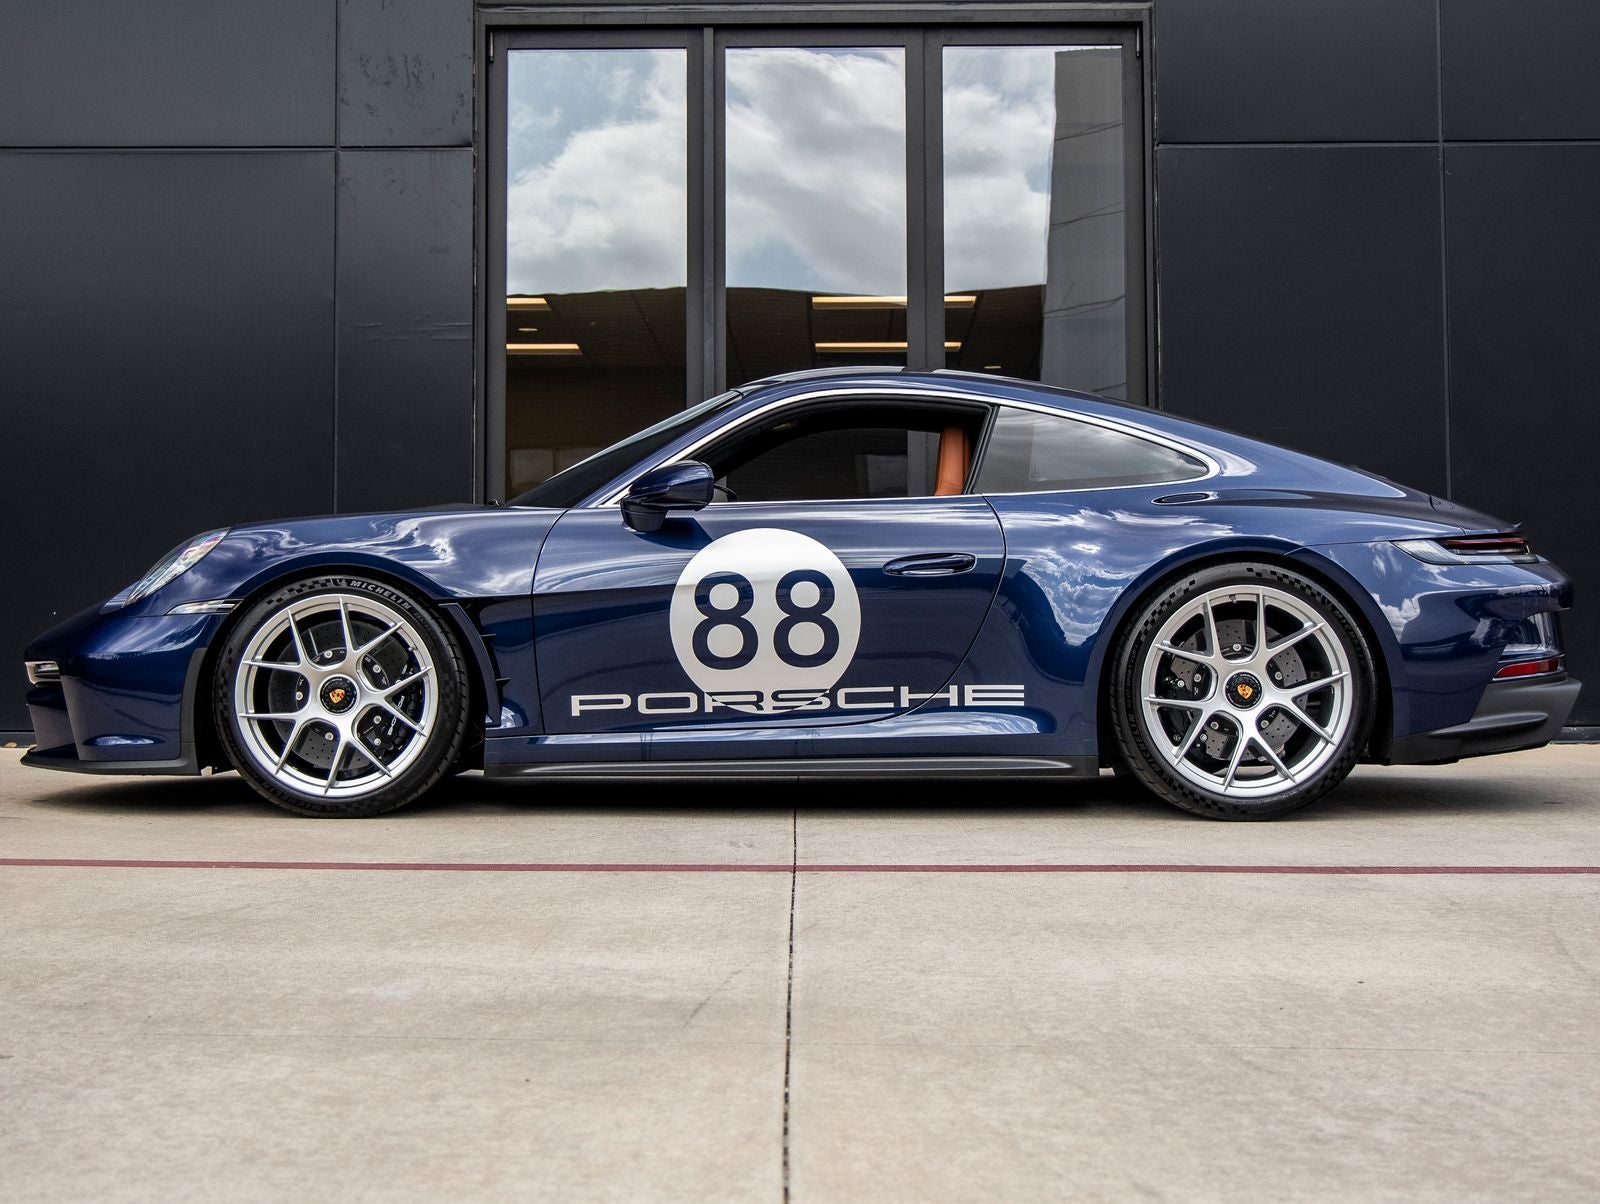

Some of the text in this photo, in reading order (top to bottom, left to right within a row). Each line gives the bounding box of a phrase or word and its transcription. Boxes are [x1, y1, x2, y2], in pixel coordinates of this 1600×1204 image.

[350, 580, 412, 611] MICHELIN
[692, 569, 839, 670] 88
[571, 684, 1025, 717] PORSCHE
